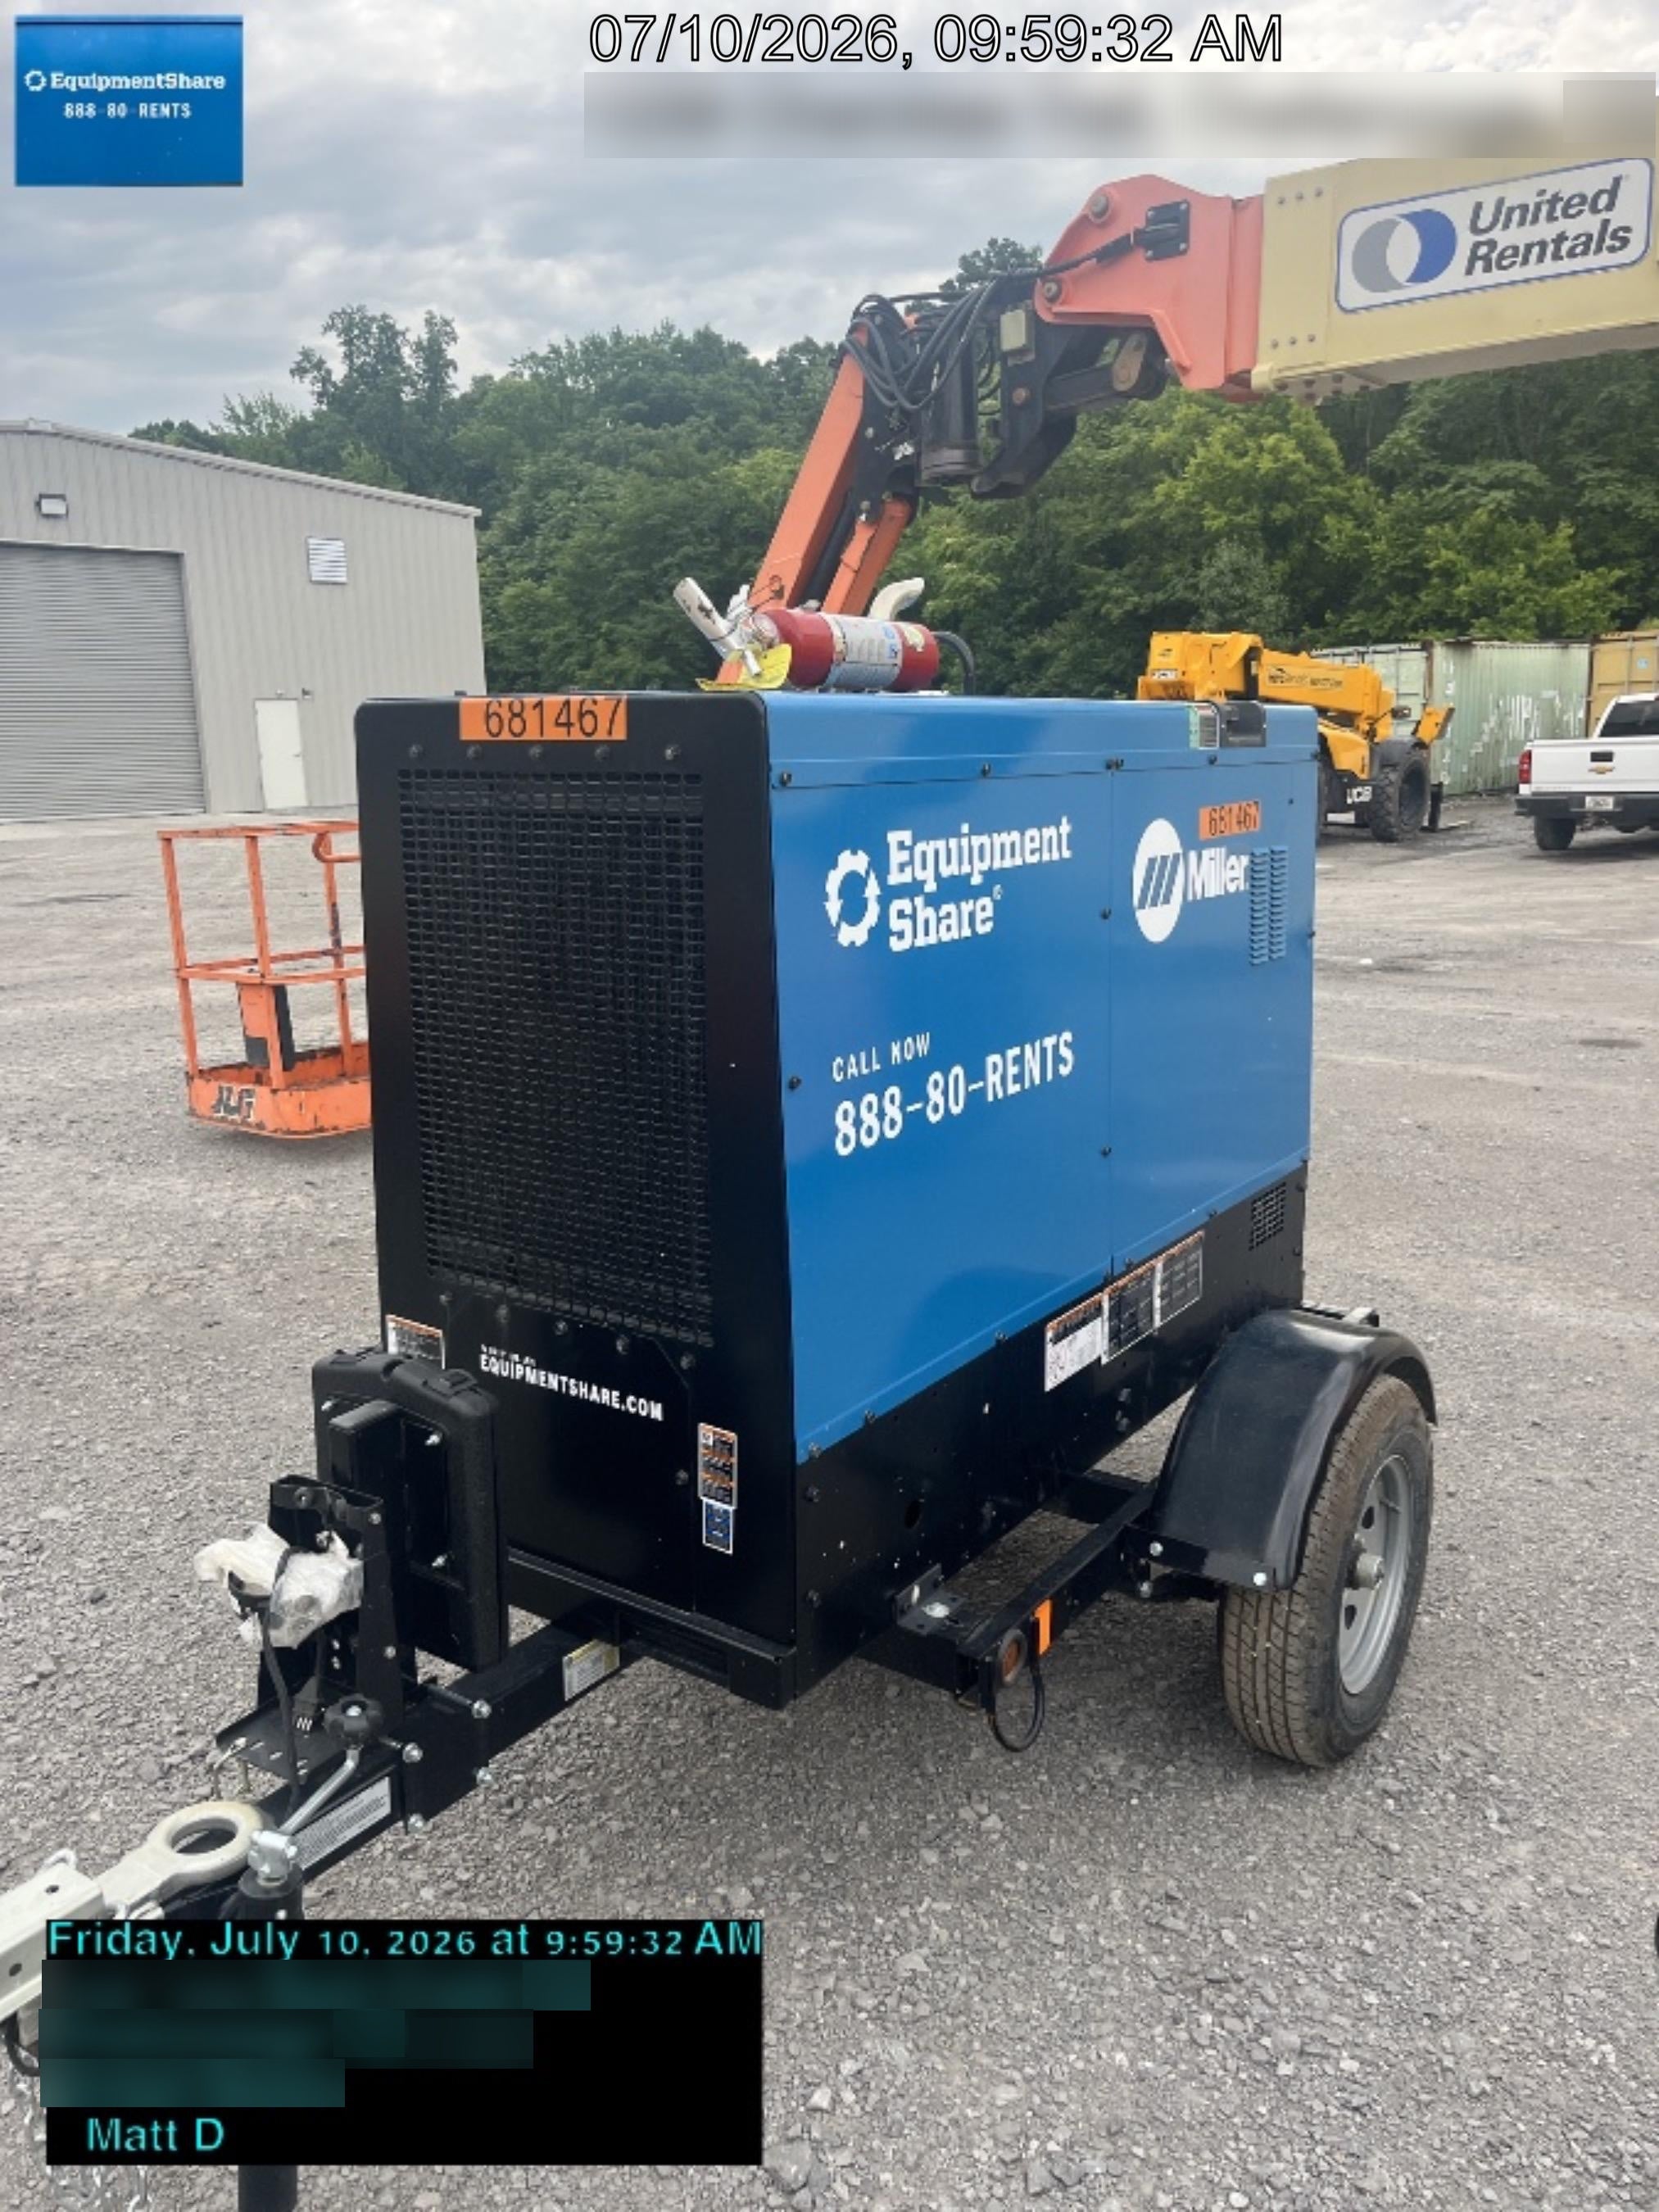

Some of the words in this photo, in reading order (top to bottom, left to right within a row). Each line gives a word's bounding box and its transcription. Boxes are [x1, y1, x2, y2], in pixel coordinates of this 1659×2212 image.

[1469, 173, 1624, 236] United
[1464, 219, 1633, 277] Rentals
[485, 697, 623, 738] 681467
[886, 817, 1072, 893] Equipment
[889, 893, 994, 952] Share
[832, 1047, 881, 1082] CALL
[891, 1032, 931, 1065] NOW
[834, 1031, 1075, 1157] 888-80-RENTS
[480, 1353, 664, 1421] EQUIPMENTSHARE.COM
